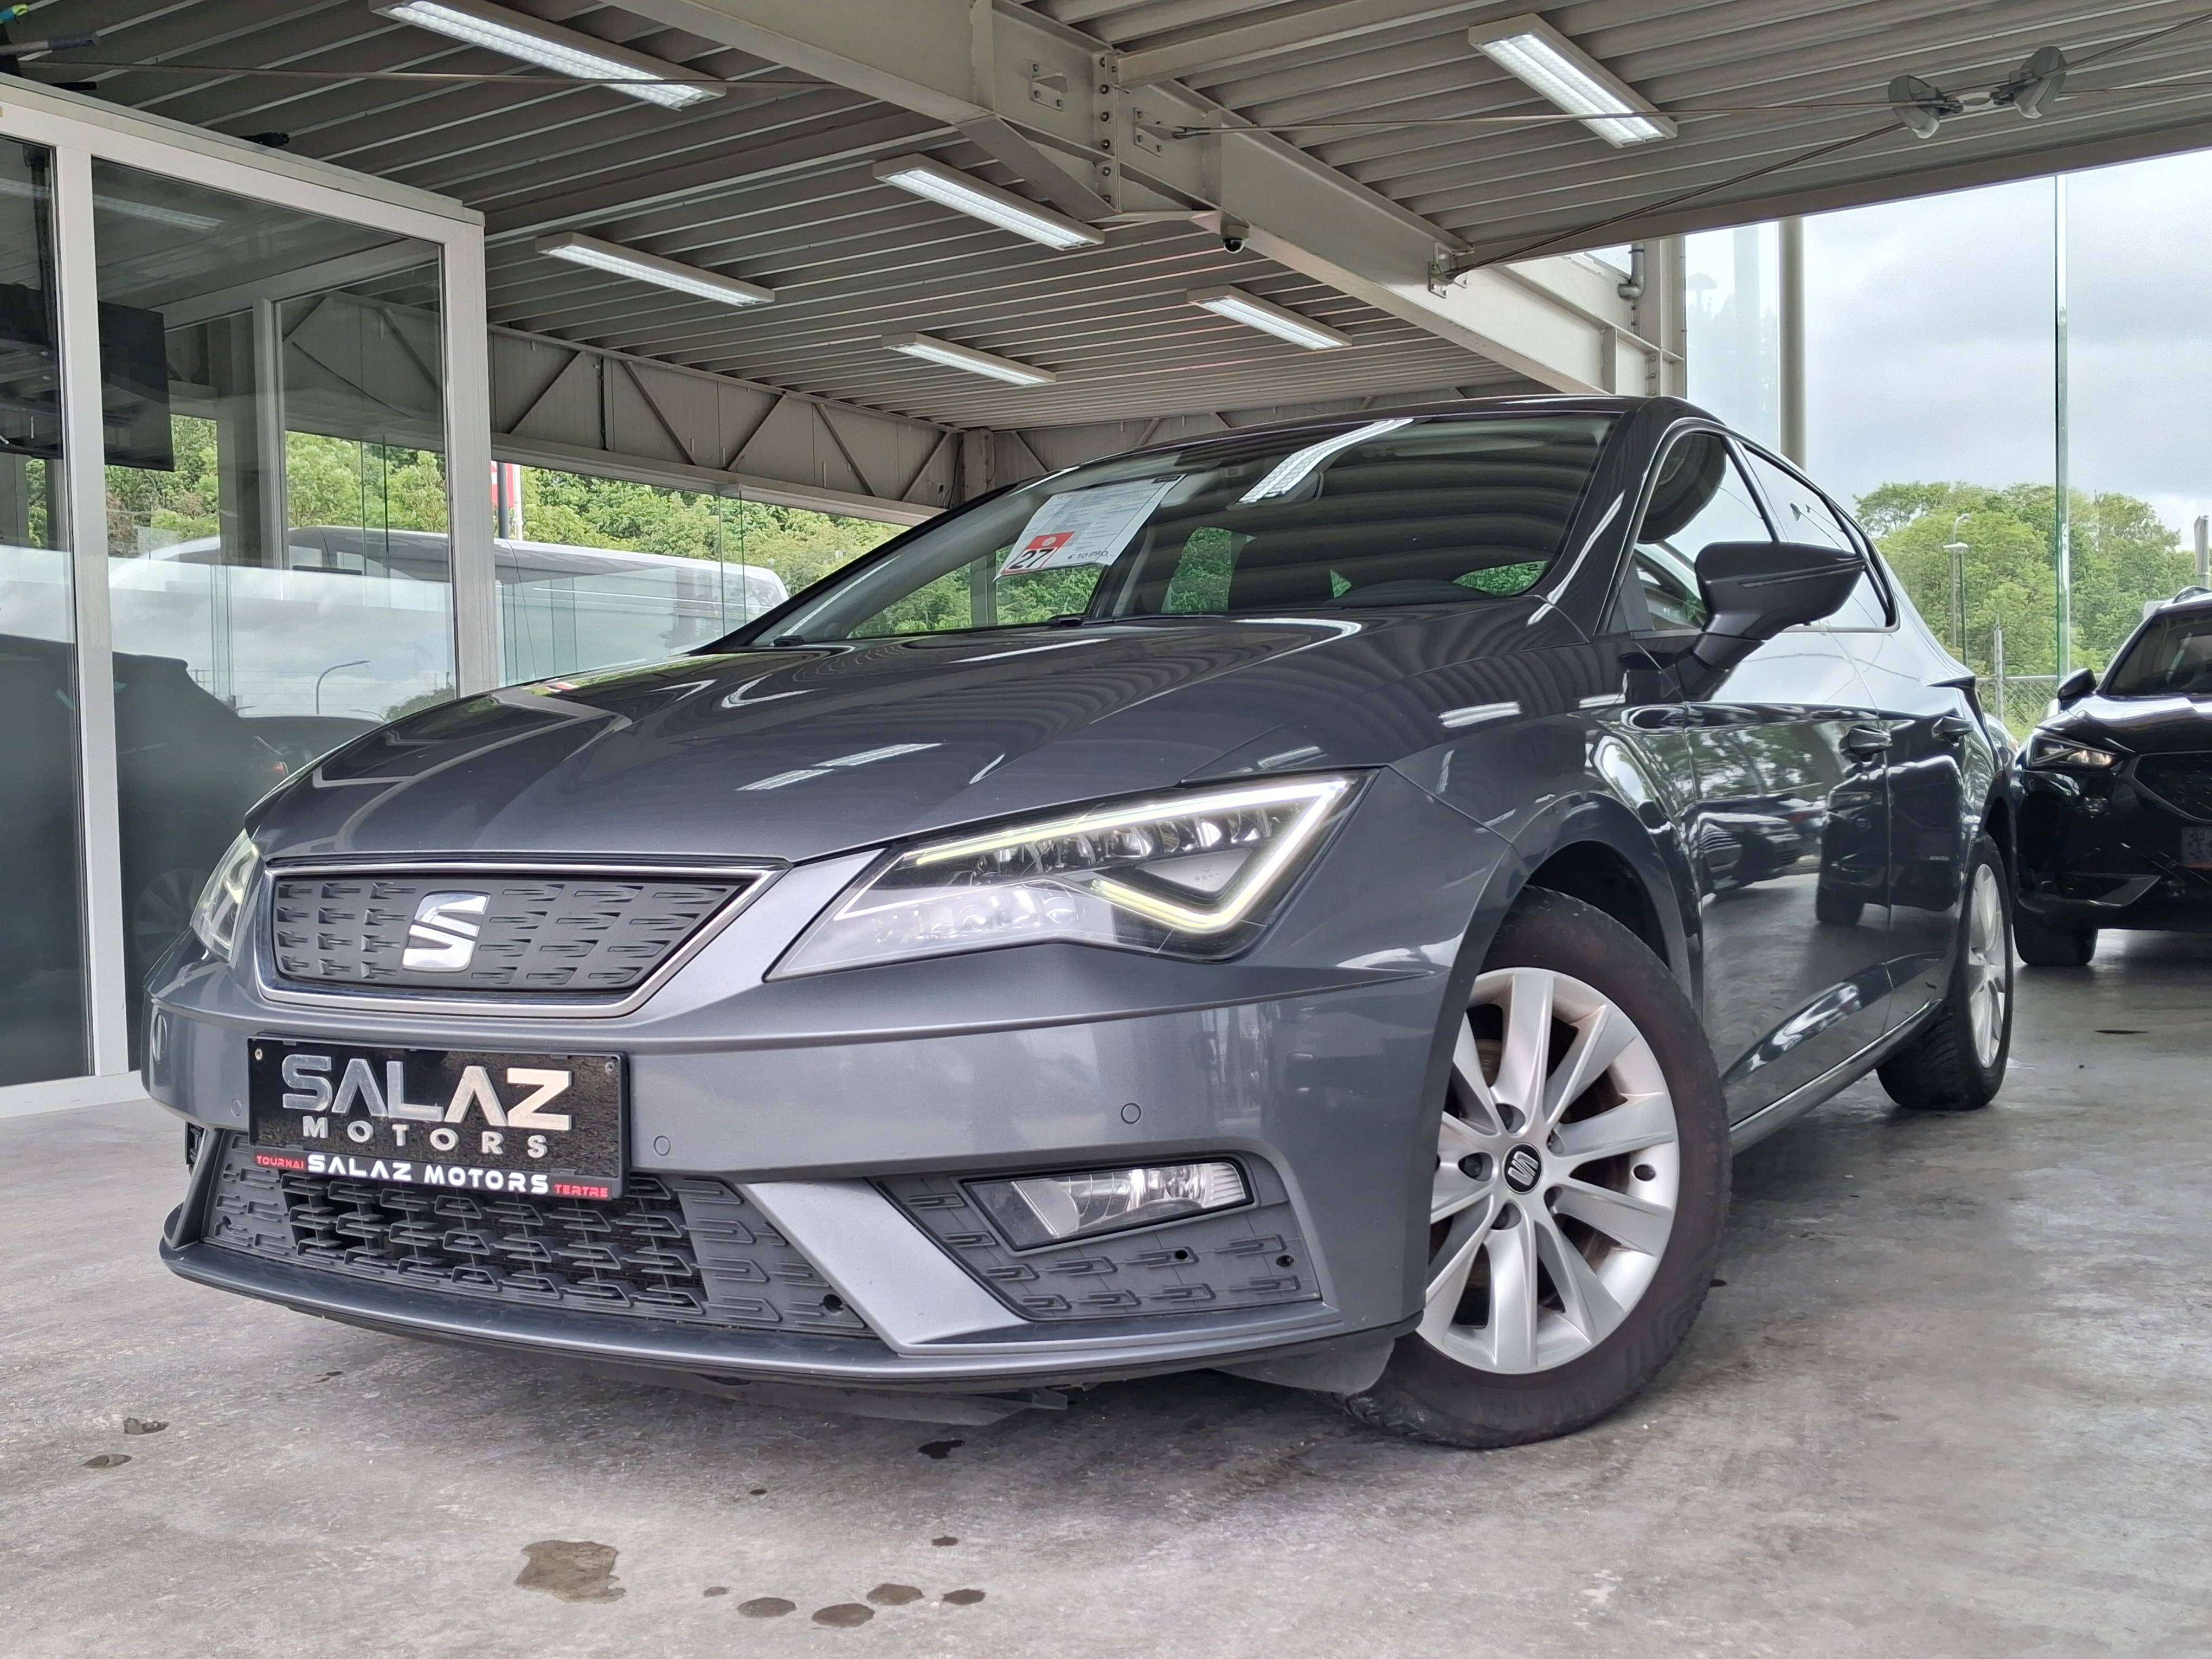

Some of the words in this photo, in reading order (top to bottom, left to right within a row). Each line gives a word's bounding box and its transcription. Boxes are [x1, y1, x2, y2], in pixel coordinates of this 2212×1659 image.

[1008, 548, 1055, 569] 27
[281, 1053, 572, 1131] SALAZ
[302, 1115, 548, 1158] MOTORS
[256, 1154, 304, 1169] TOURNAI
[307, 1154, 412, 1182] SALAZ
[423, 1164, 549, 1194] MOTORS
[554, 1183, 609, 1199] TERTRE
